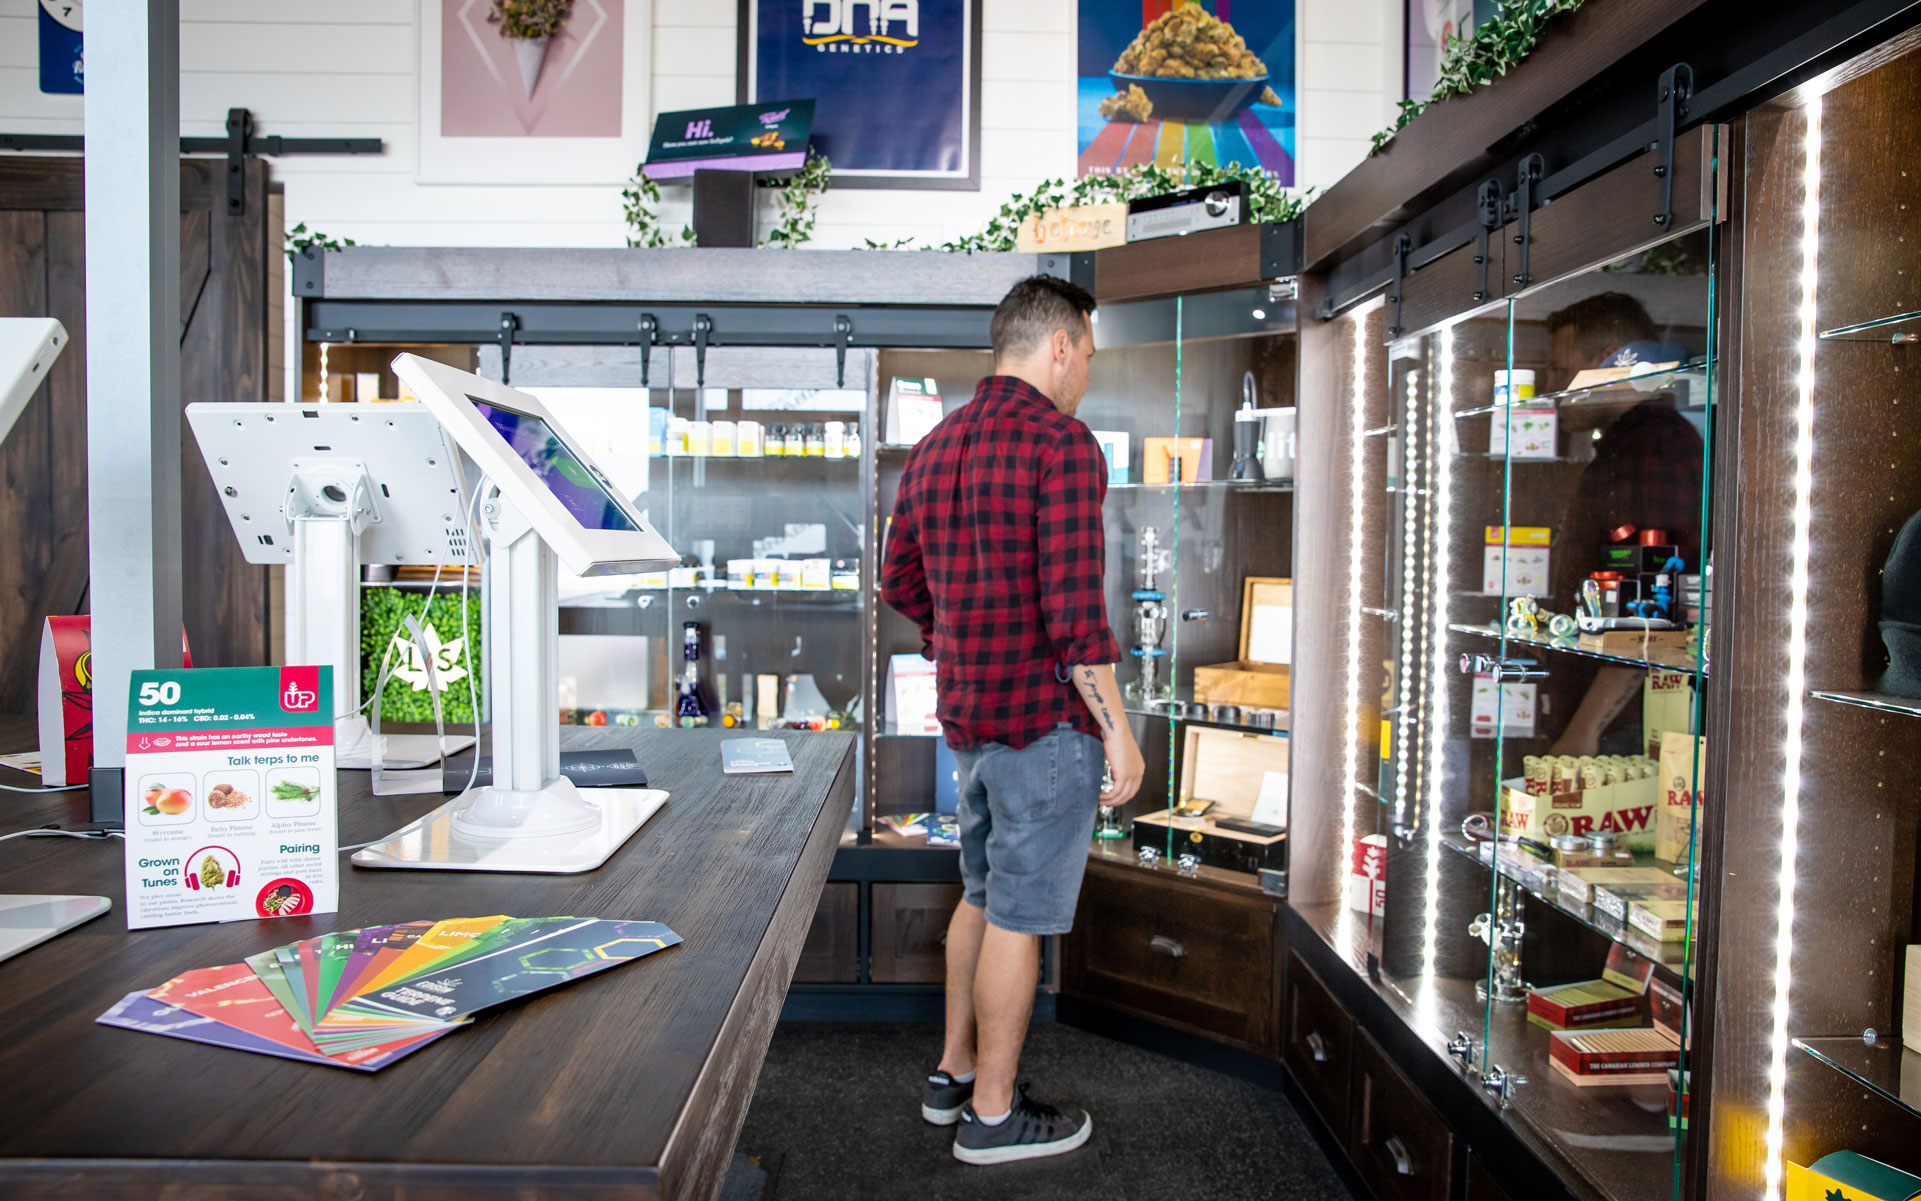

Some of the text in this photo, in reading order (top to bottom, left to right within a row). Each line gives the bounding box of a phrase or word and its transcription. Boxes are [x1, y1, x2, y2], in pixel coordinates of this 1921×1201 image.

[62, 6, 72, 17] 7
[802, 0, 919, 37] DNA
[816, 43, 905, 54] GENETICS
[685, 119, 714, 139] Hi.
[1034, 213, 1112, 244] believe
[1651, 674, 1684, 690] RAW
[138, 681, 181, 706] 50
[284, 690, 316, 709] UP
[232, 733, 252, 741] earthy
[227, 753, 320, 766] Talk terps to me
[1500, 808, 1529, 830] RAW
[1570, 804, 1654, 837] RAW
[280, 843, 320, 854] Pairing
[138, 858, 180, 868] Grown
[163, 867, 179, 876] on
[141, 878, 178, 888] Tunes
[380, 991, 425, 1007] GUIDE
[395, 986, 456, 1006] TERPENE
